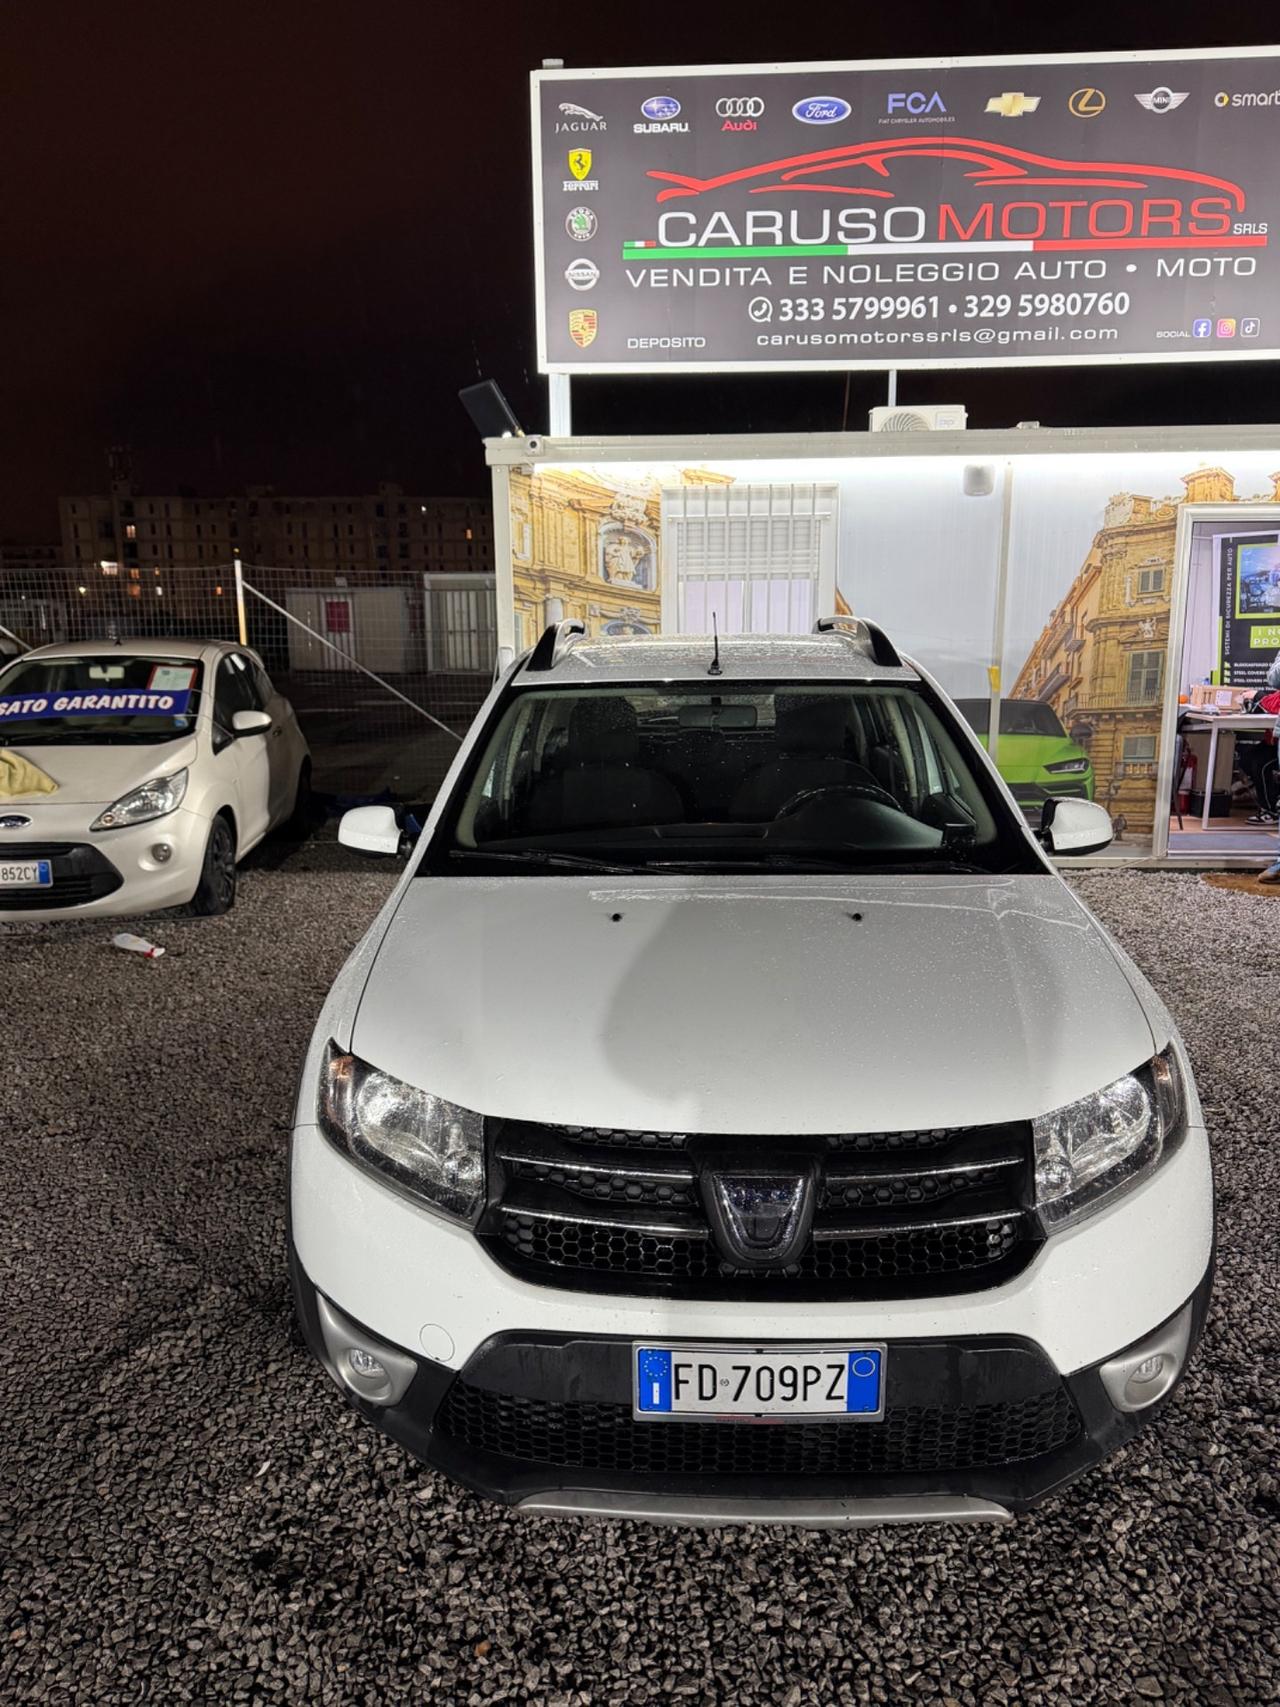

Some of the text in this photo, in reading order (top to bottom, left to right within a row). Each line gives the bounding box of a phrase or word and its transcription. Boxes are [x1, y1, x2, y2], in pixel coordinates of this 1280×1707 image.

[887, 91, 947, 114] FCA
[1231, 90, 1280, 107] smart
[805, 102, 838, 118] Ford
[555, 121, 608, 134] JAGUAR
[633, 122, 689, 133] SUBARU
[721, 120, 758, 131] Audi
[562, 180, 599, 192] Ferrari
[658, 197, 1268, 247] CARUSO MOTORS SRLS
[625, 257, 1257, 288] VENDITA E NOLEGGIO AUTO MOTO
[778, 292, 1130, 322] 333 5799961 329 5980760
[757, 327, 1118, 346] carusomotorssrls@gmail.com
[1156, 330, 1191, 338] SOCIAL
[627, 336, 706, 349] DEPOSITO
[53, 695, 174, 711] GARANTITO
[1, 866, 37, 881] 852CY
[674, 1363, 846, 1402] FD 709PZ
